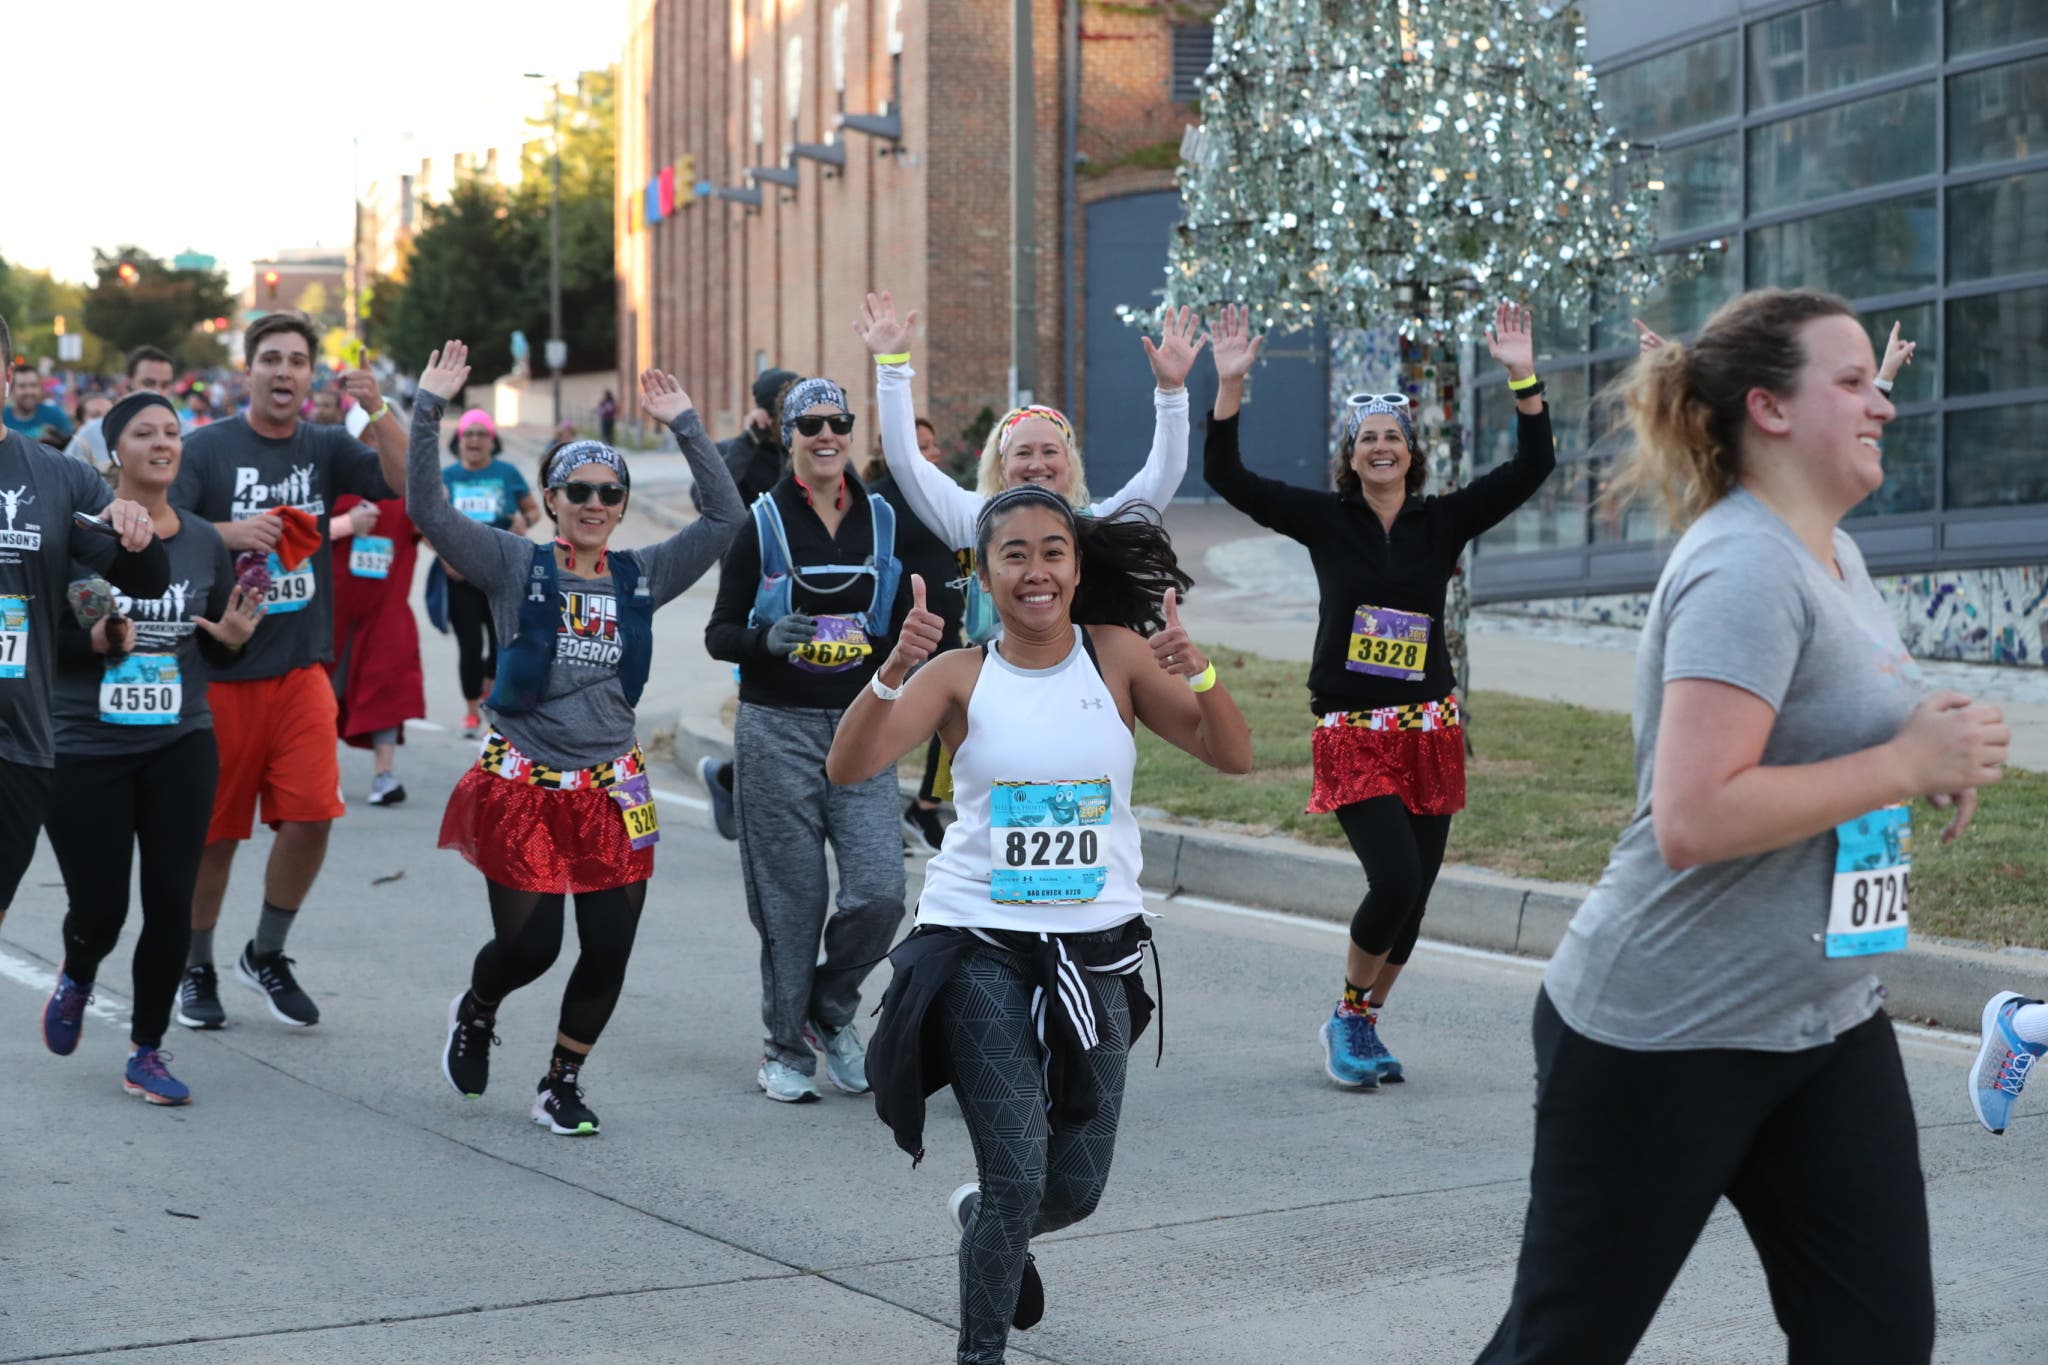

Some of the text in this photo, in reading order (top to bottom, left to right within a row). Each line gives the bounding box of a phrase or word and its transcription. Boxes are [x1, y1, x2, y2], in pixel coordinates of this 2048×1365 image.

[266, 577, 307, 601] 549
[1357, 638, 1418, 668] 3328
[109, 686, 173, 711] 4550
[629, 804, 656, 834] 328
[1079, 805, 1106, 818] 2019
[1005, 829, 1098, 867] 8220
[1027, 889, 1040, 897] BAG
[1041, 889, 1062, 897] CHECK
